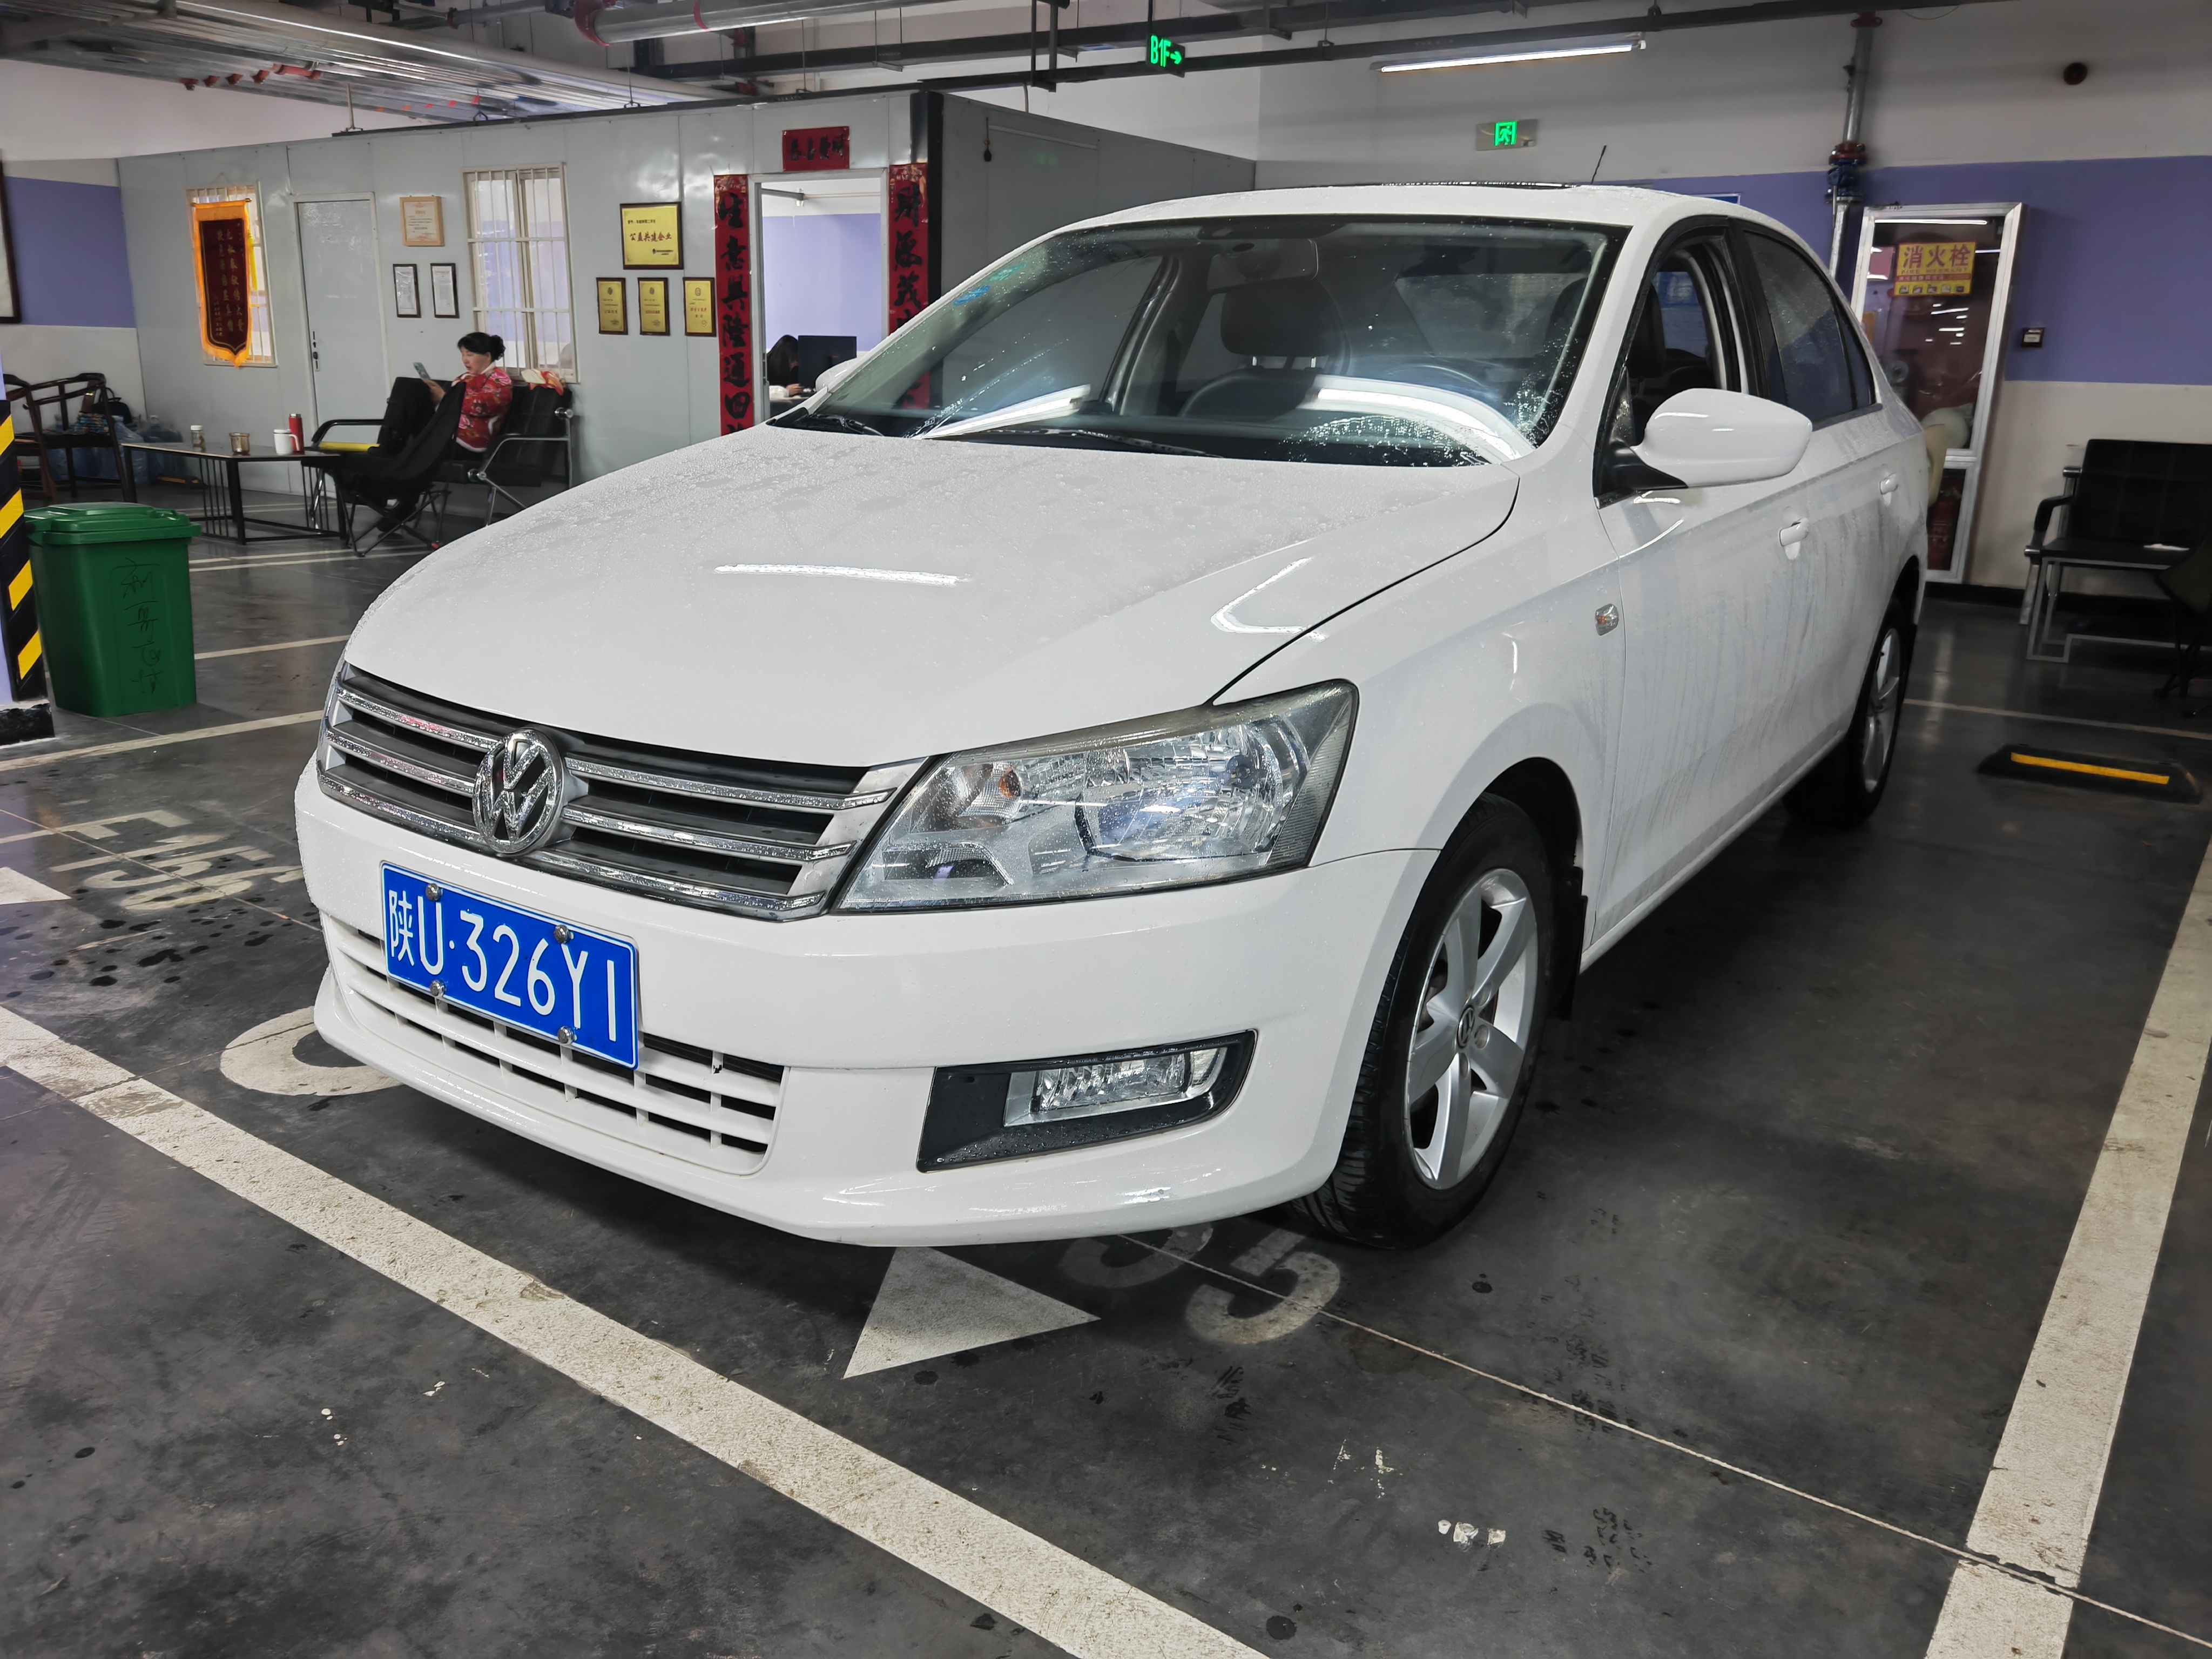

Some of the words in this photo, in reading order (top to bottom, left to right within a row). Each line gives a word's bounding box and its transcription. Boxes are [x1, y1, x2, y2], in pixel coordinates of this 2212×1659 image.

[1150, 35, 1171, 68] B1F
[1903, 244, 1971, 269] 消火栓
